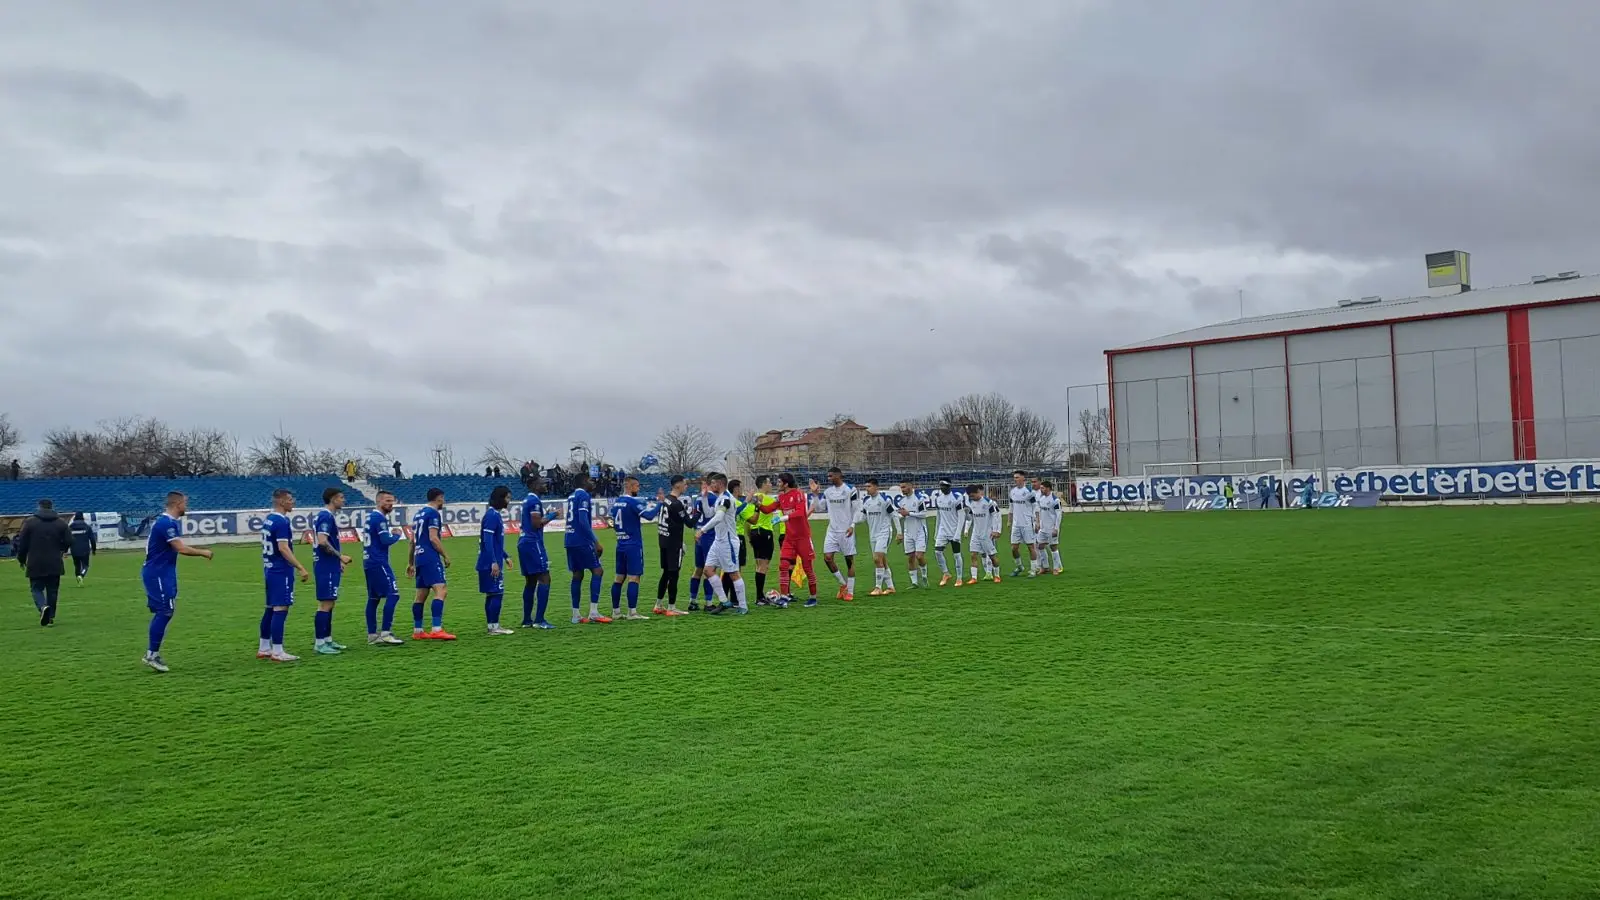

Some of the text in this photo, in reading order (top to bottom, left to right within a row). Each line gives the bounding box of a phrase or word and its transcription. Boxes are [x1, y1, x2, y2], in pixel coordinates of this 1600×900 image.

[1156, 477, 1228, 499] efbet
[1333, 471, 1426, 494] efbet
[1434, 467, 1533, 494] efbet
[1544, 465, 1600, 490] efb
[1082, 480, 1145, 500] efbet
[182, 515, 228, 535] bet
[442, 506, 481, 524] bet
[614, 508, 623, 529] 4
